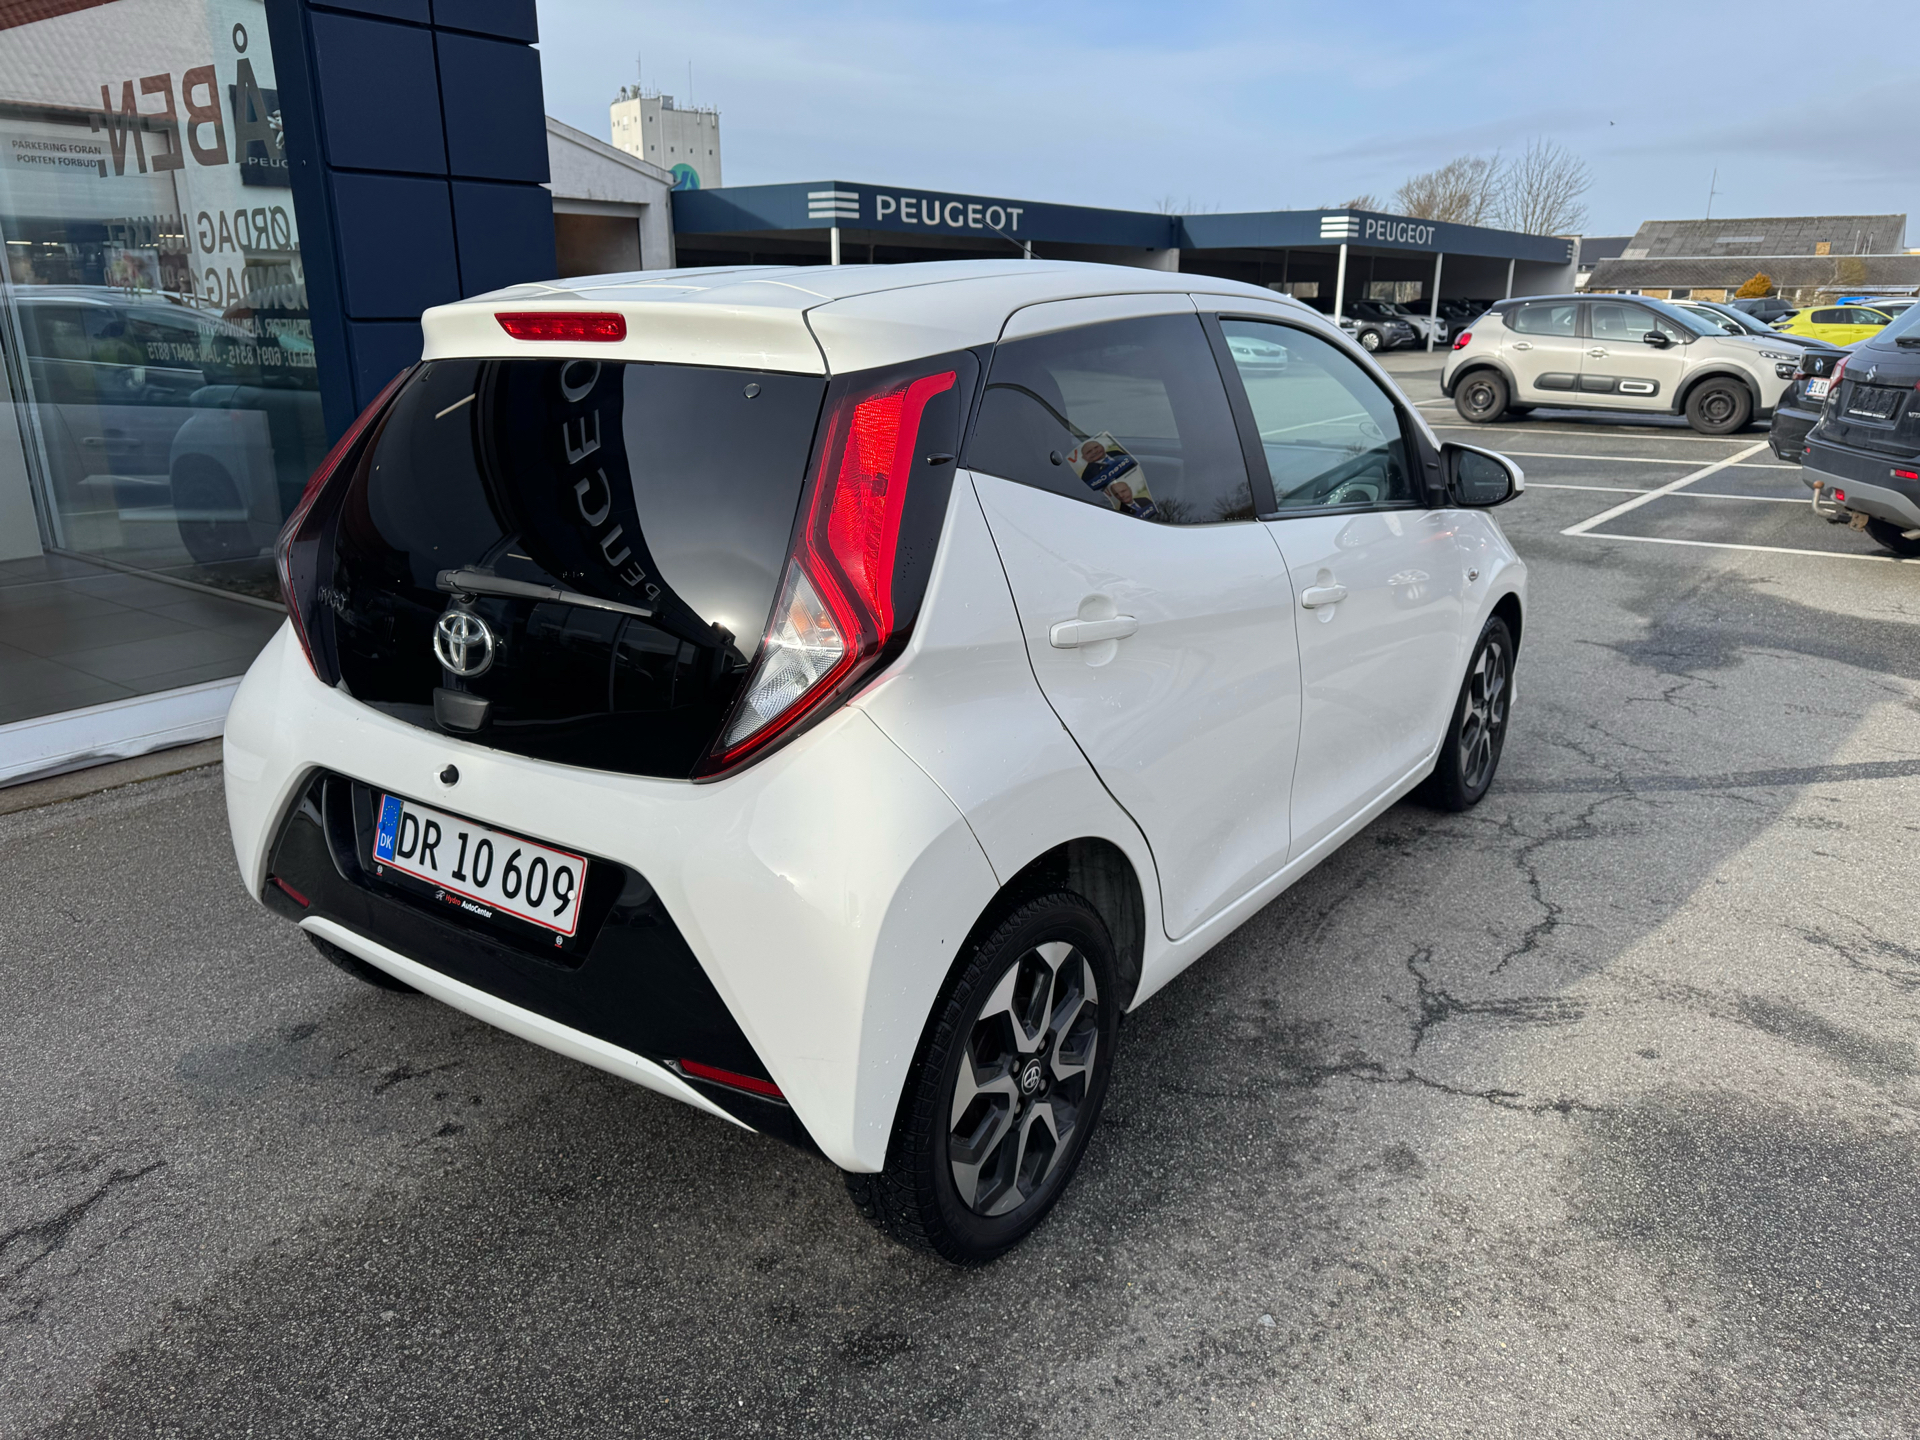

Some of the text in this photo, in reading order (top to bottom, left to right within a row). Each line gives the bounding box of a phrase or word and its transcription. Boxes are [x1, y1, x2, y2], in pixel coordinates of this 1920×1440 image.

[11, 140, 102, 155] PARKERING FORAN
[16, 153, 103, 169] PORTEN FORBUD
[876, 194, 1024, 231] PEUGEOT
[1365, 218, 1436, 246] PEUGEOT
[380, 833, 393, 850] DK
[397, 811, 575, 918] DR 10 609
[445, 893, 493, 919] Hydro AutoCenter
